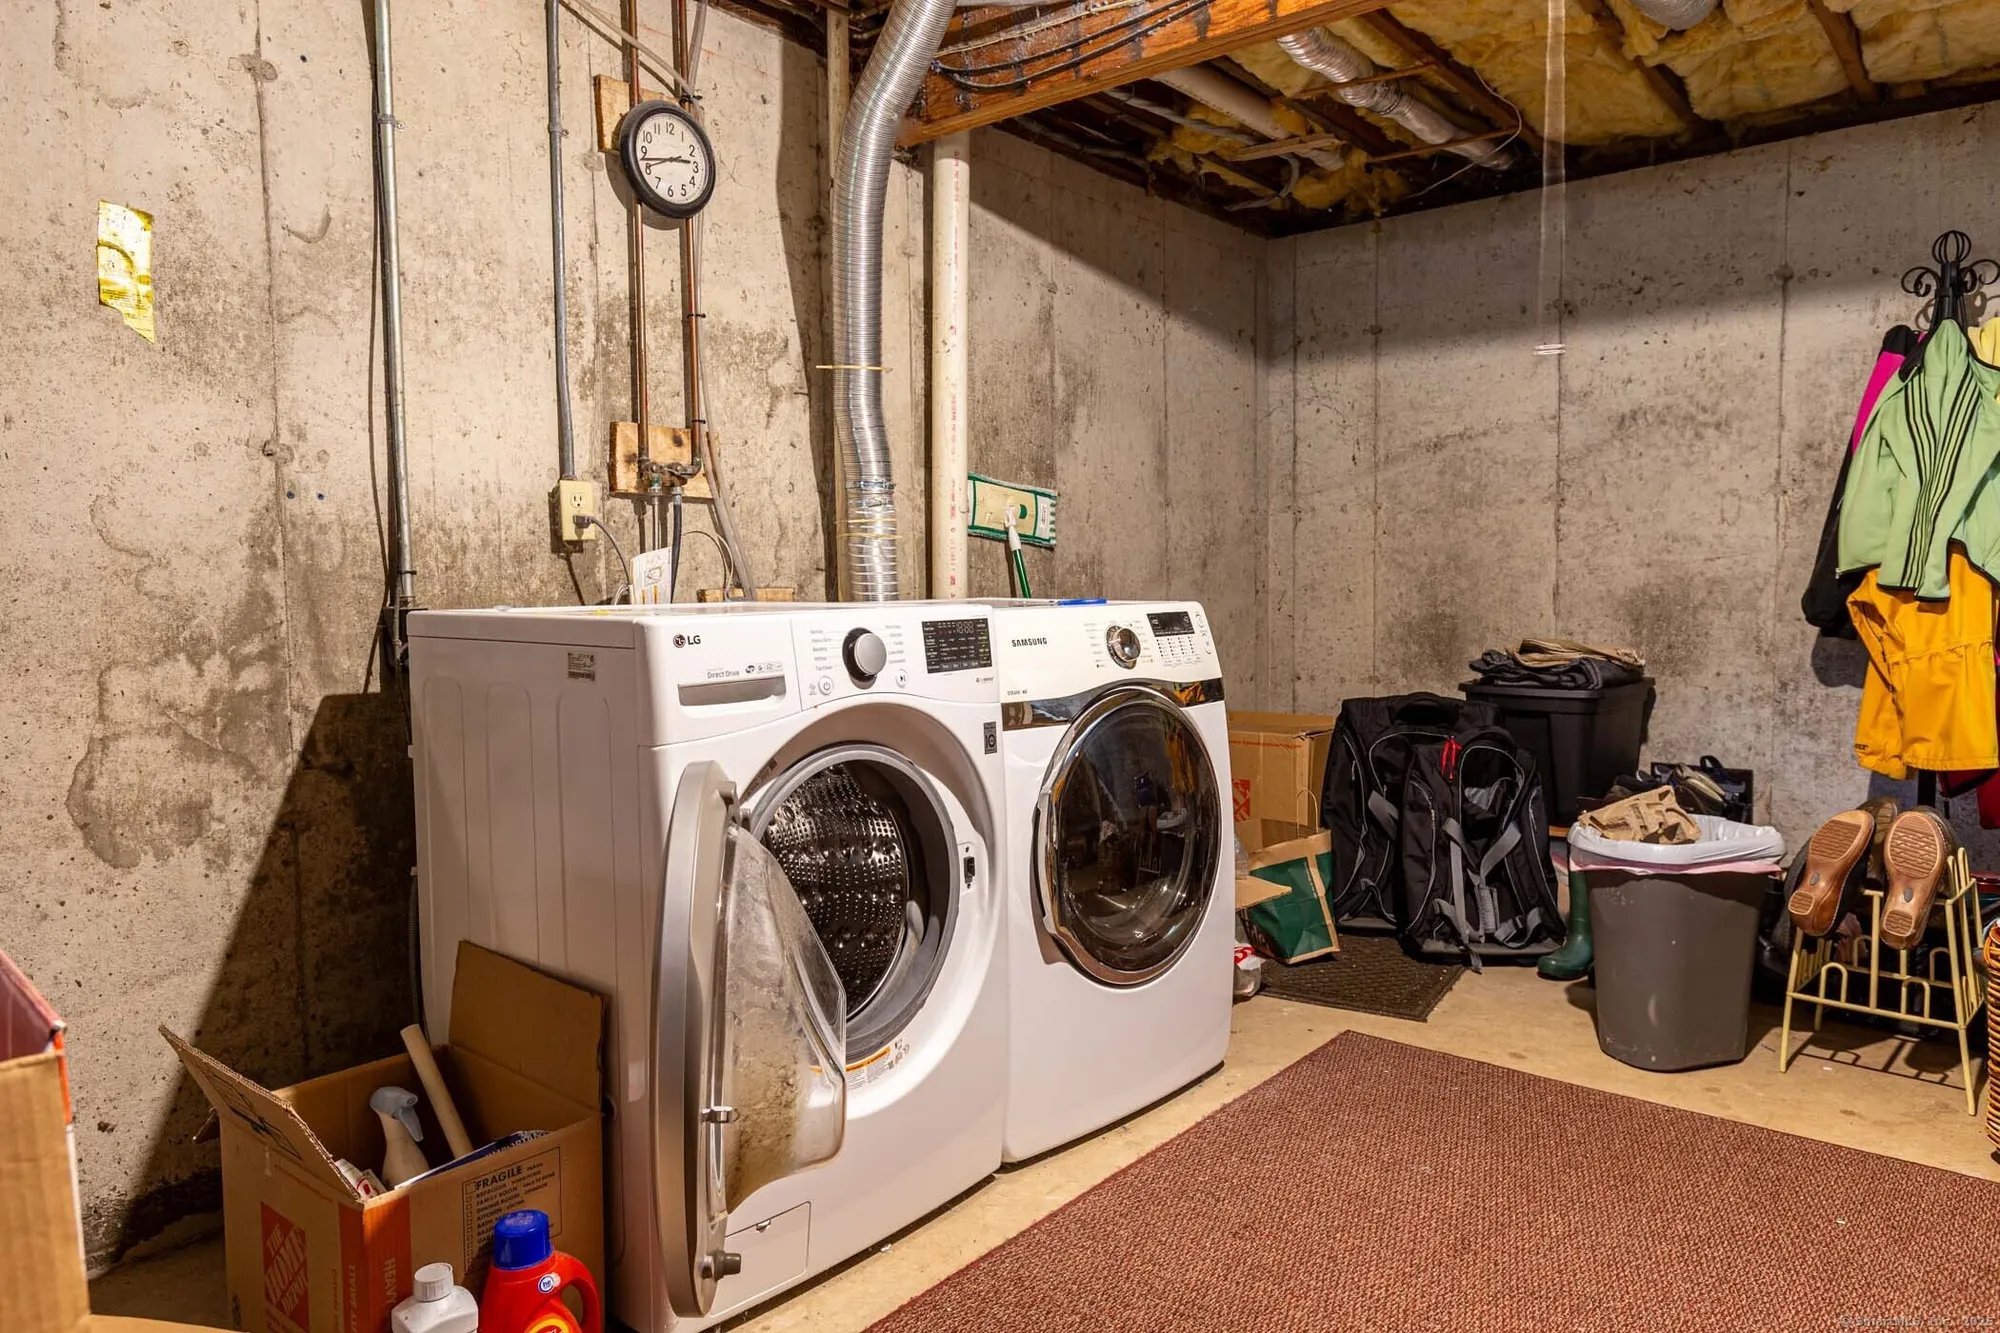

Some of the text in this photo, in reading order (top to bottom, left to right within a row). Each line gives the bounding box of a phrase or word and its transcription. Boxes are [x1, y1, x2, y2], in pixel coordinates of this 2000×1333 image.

[654, 122, 660, 135] 11
[666, 122, 675, 135] 12
[643, 131, 652, 143] 10
[641, 145, 648, 159] 9
[689, 144, 695, 157] 2
[645, 163, 652, 175] 8
[693, 161, 699, 173] 3
[655, 176, 661, 189] 7
[689, 175, 696, 188] 4
[667, 185, 674, 197] 6
[681, 184, 687, 196] 5
[687, 635, 701, 645] LG
[1011, 637, 1047, 647] SAMSUNG
[707, 670, 739, 679] Direct Drive
[475, 1166, 523, 1190] FRAGILE
[383, 1257, 397, 1304] HEAVY
